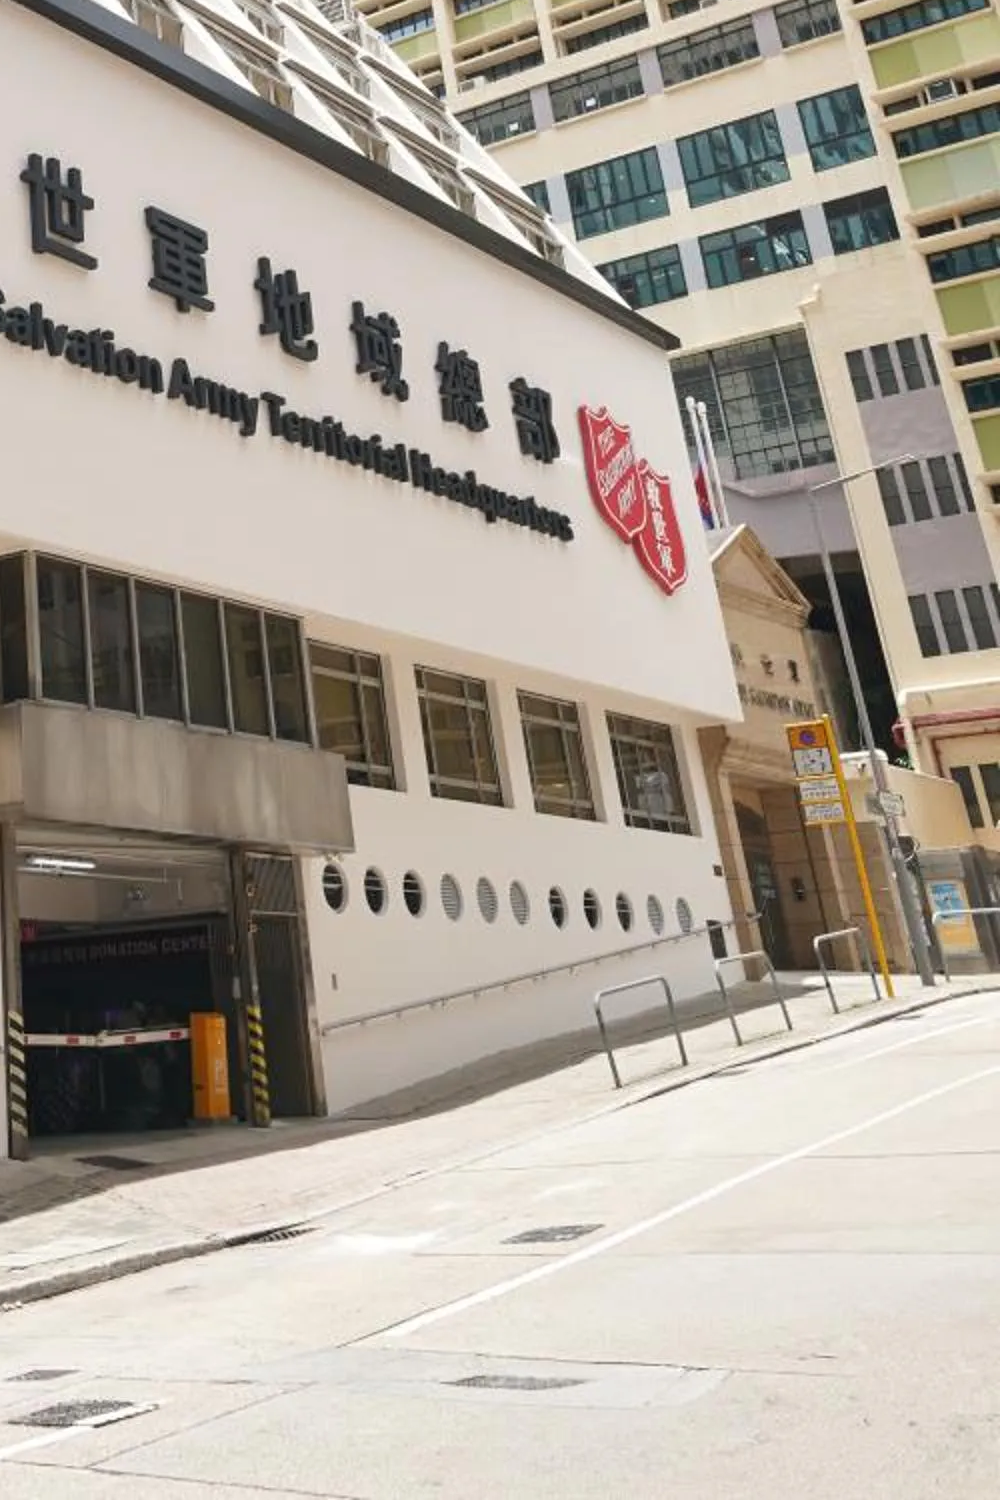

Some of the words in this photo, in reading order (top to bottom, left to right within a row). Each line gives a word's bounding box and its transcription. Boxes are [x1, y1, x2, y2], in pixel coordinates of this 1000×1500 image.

[167, 358, 258, 437] Army
[260, 392, 409, 482] Territorial
[409, 449, 574, 542] Headquarters
